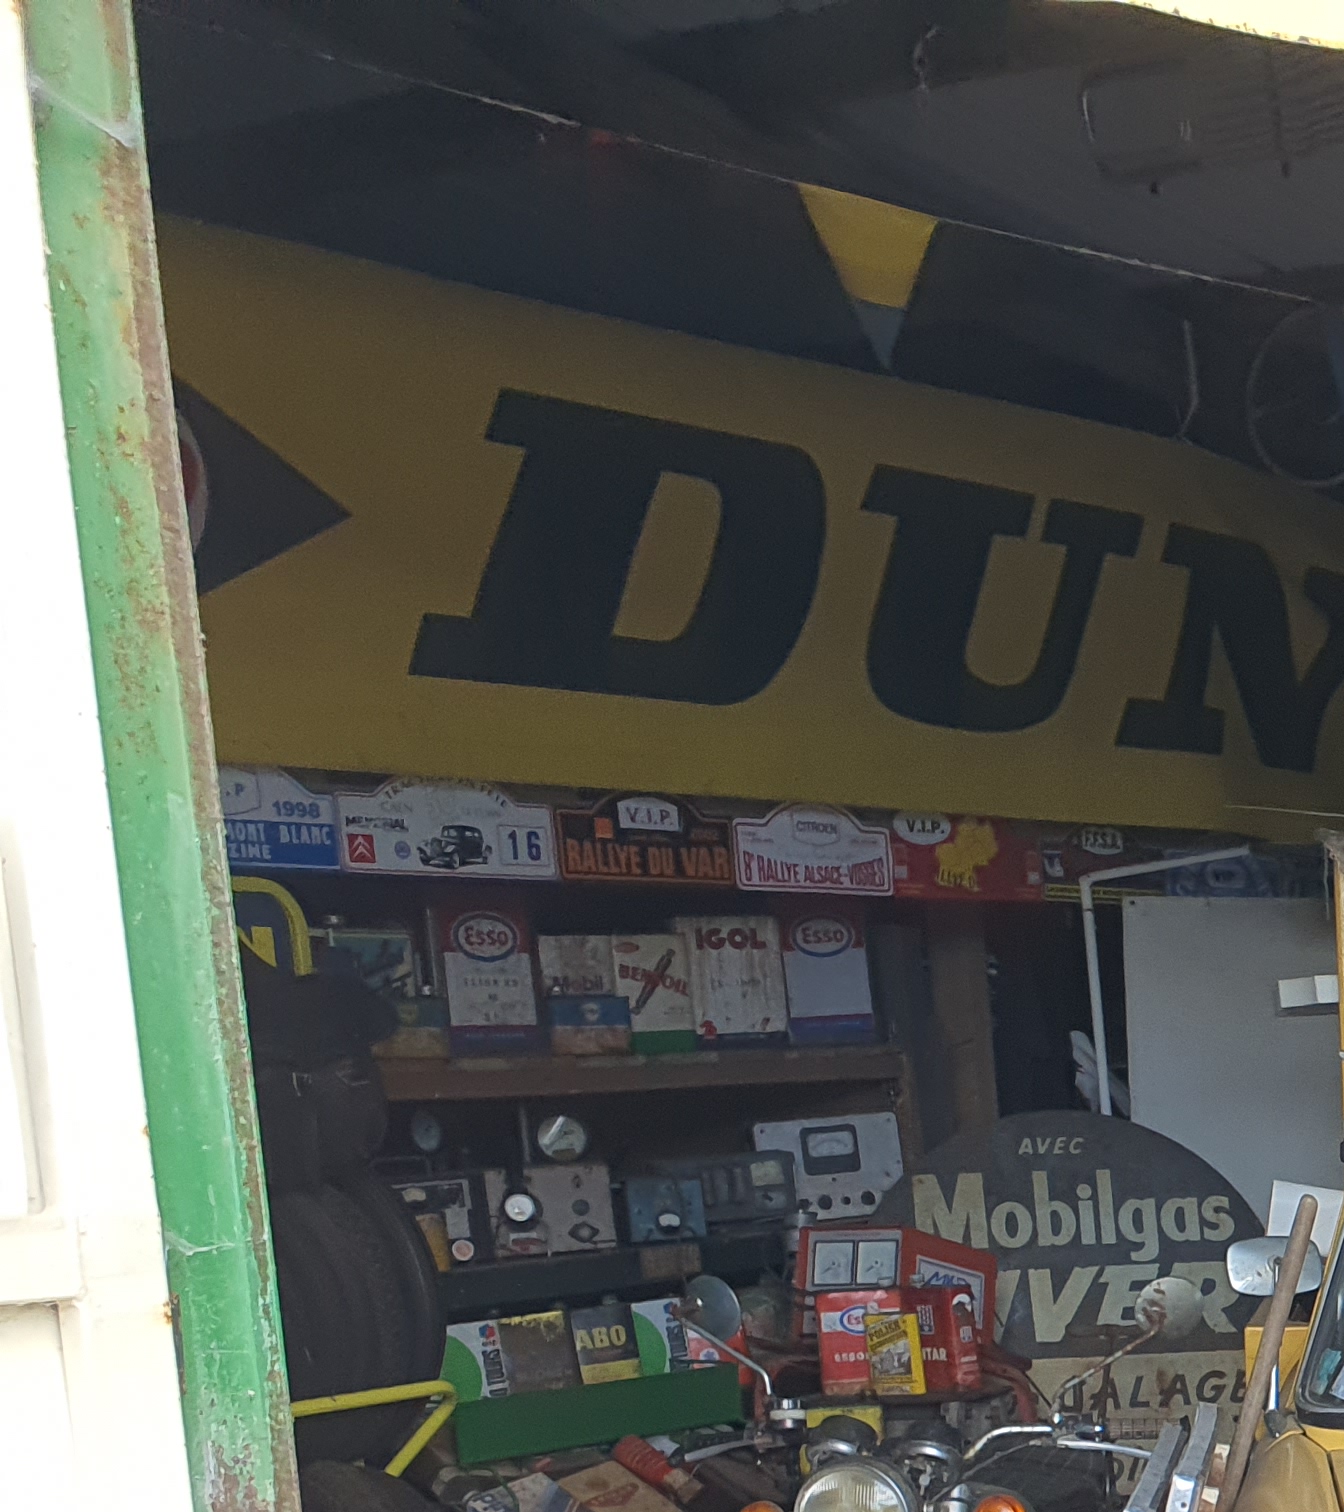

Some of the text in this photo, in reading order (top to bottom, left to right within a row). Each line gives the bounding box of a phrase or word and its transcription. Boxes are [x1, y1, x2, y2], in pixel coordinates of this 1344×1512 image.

[272, 801, 320, 819] 1998
[280, 826, 331, 846] BLANC
[508, 830, 541, 861] 16
[567, 838, 729, 878] RALLYE DU VAR
[758, 855, 799, 883] RALLYE
[696, 927, 768, 951] IGOL
[1018, 1137, 1085, 1155] AVEC
[911, 1168, 1236, 1262] Mobilgas
